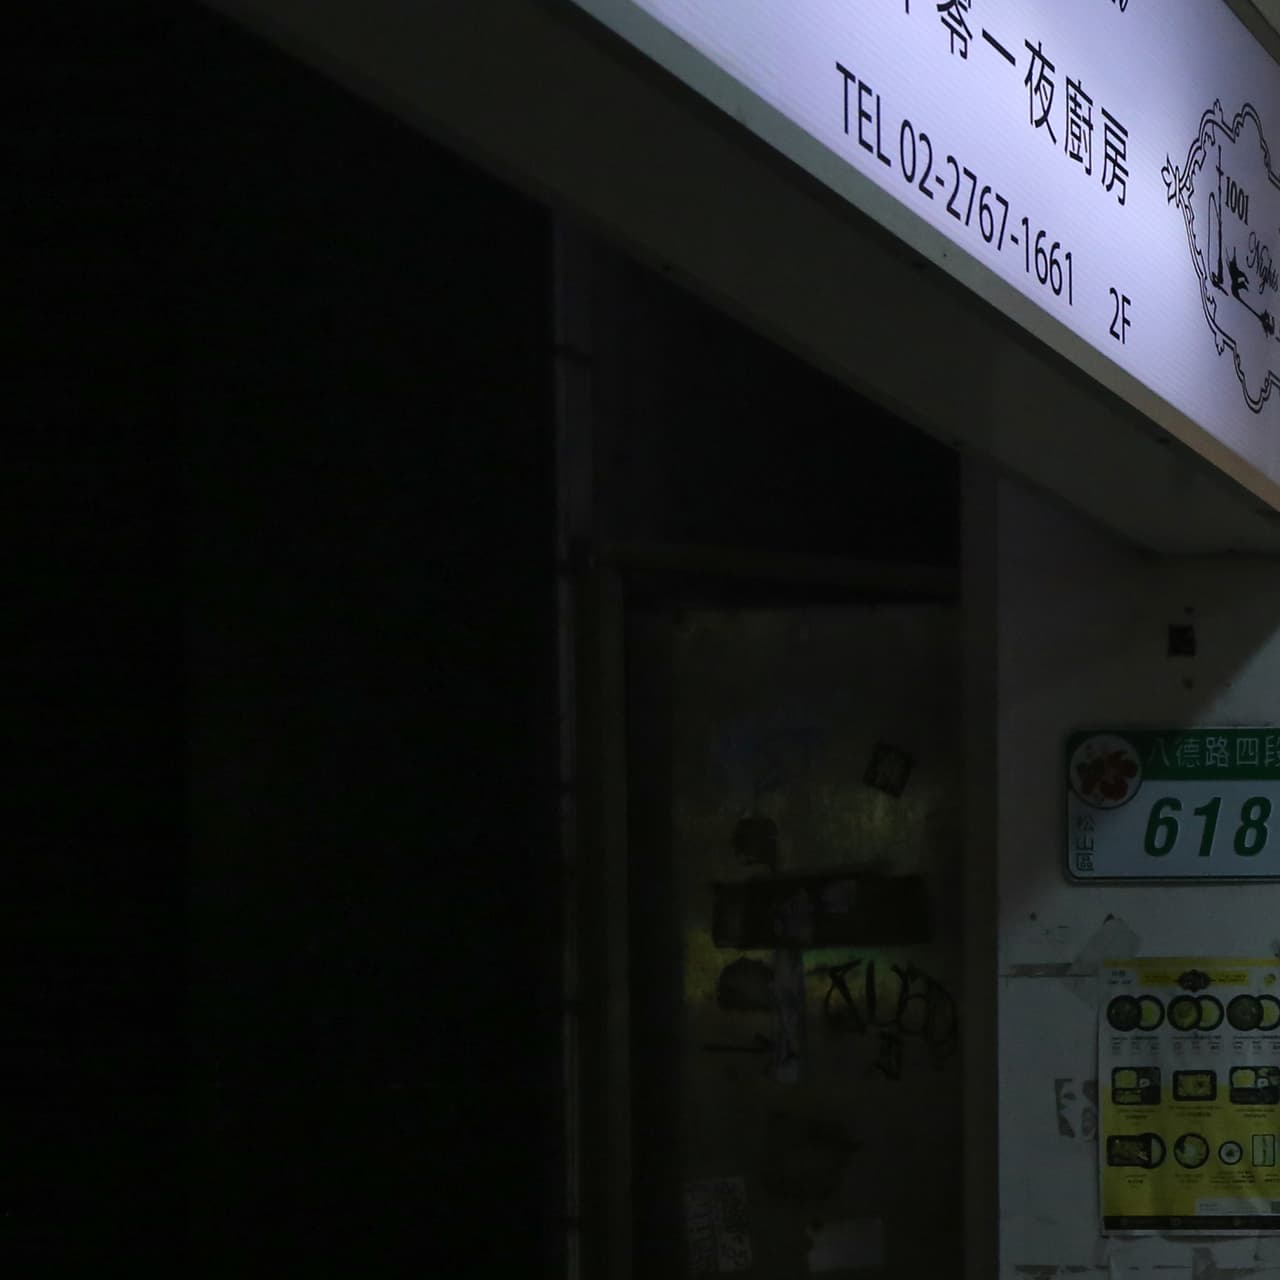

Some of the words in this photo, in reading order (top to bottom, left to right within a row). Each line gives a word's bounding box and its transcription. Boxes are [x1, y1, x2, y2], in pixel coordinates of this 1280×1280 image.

[902, 0, 1129, 207] 零一夜廚房
[835, 61, 892, 168] TEL
[899, 119, 1075, 306] 02-2767-1661
[1109, 286, 1132, 345] 2F
[1225, 176, 1249, 226] 1001
[1144, 796, 1273, 858] 618
